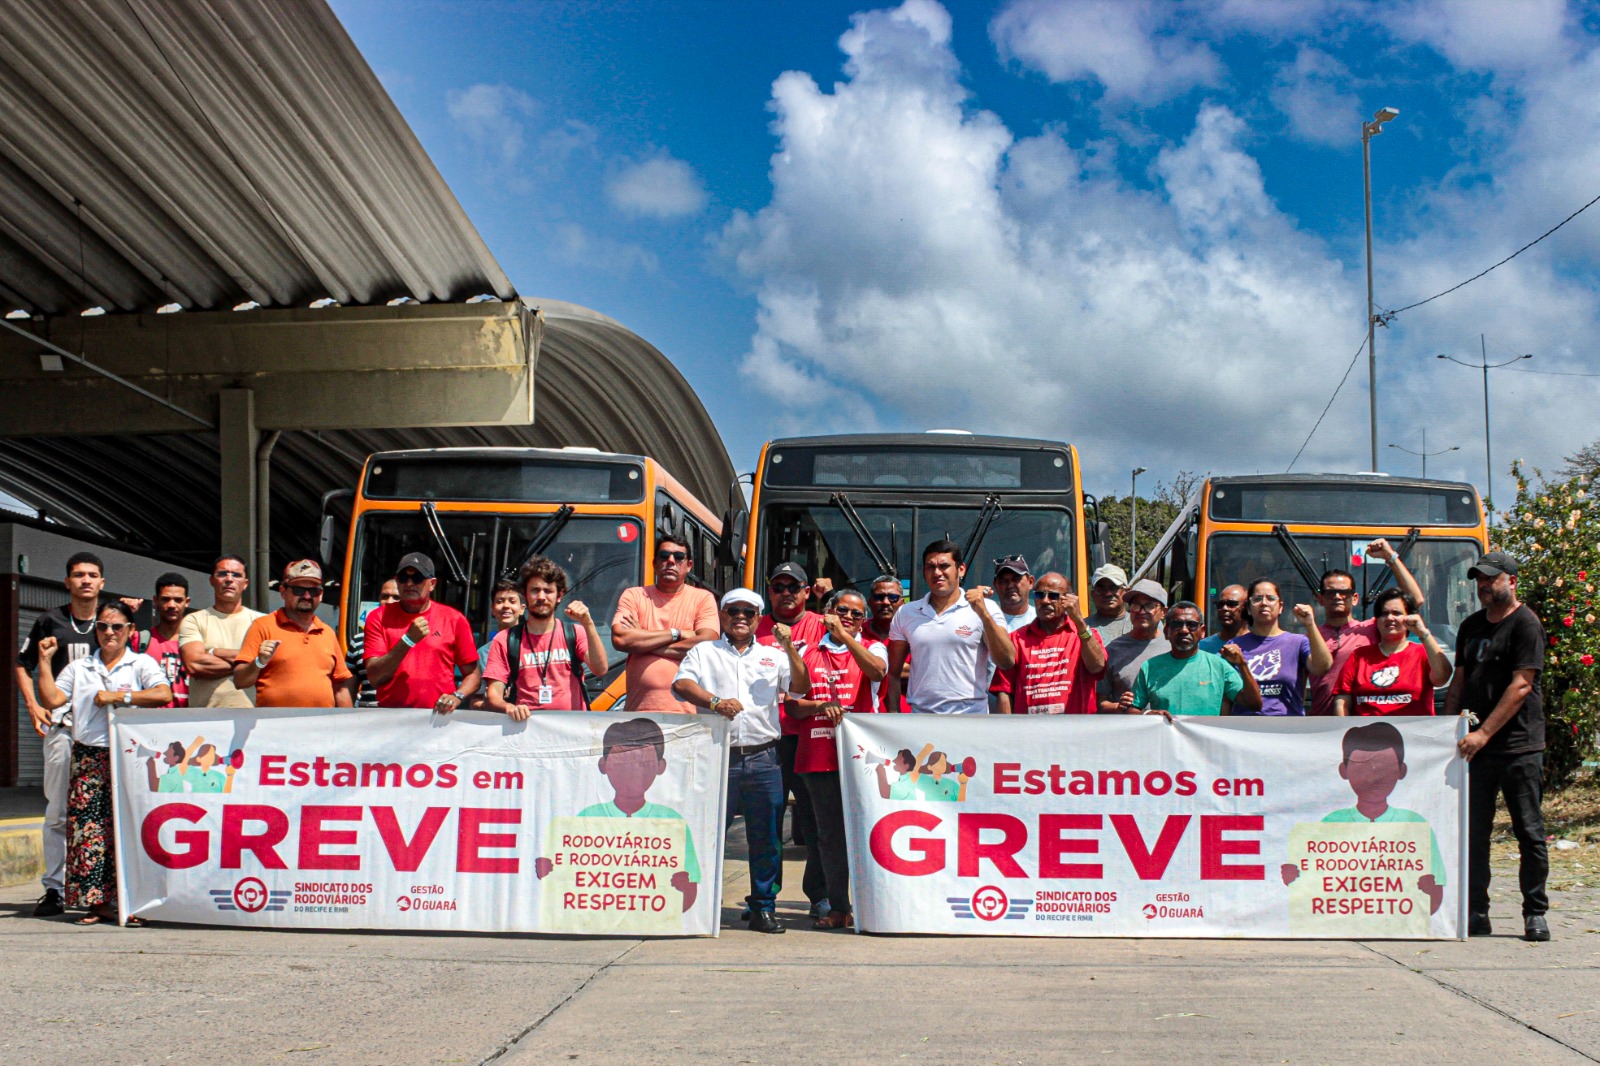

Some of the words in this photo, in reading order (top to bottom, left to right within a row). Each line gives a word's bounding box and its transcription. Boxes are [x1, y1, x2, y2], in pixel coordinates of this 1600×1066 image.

[259, 755, 459, 789] Estamos
[472, 771, 525, 790] em
[993, 763, 1197, 796] Estamos
[1212, 778, 1265, 797] em
[141, 803, 523, 874] GREVE
[563, 832, 672, 850] RODOVIÁRIOS
[869, 809, 1266, 881] GREVE
[1307, 836, 1416, 854] RODOVIÁRIOS
[555, 853, 563, 865] E
[569, 850, 679, 868] RODOVIÁRIAS
[1300, 858, 1309, 871] E
[1315, 854, 1424, 871] RODOVIÁRIAS
[294, 882, 350, 893] SINDICATO
[351, 883, 373, 894] DOS
[575, 871, 657, 889] EXIGEM
[1322, 876, 1403, 893] EXIGEM
[410, 884, 444, 895] GESTÃO
[1035, 891, 1092, 902] SINDICATO
[1094, 891, 1117, 903] DOS
[1155, 892, 1190, 903] GESTÃO
[294, 892, 366, 905] RODOVIÁRIOS
[412, 898, 420, 911] O
[421, 898, 457, 911] GUARÁ
[563, 891, 667, 912] RESPEITO
[1035, 901, 1111, 913] RODOVIÁRIOS
[1312, 897, 1414, 915] RESPEITO
[305, 906, 327, 914] RECIFE
[328, 906, 333, 914] E
[333, 906, 349, 914] RMR
[1046, 914, 1070, 922] RECIFE
[1159, 905, 1167, 918] O
[1168, 904, 1204, 918] GUARÁ
